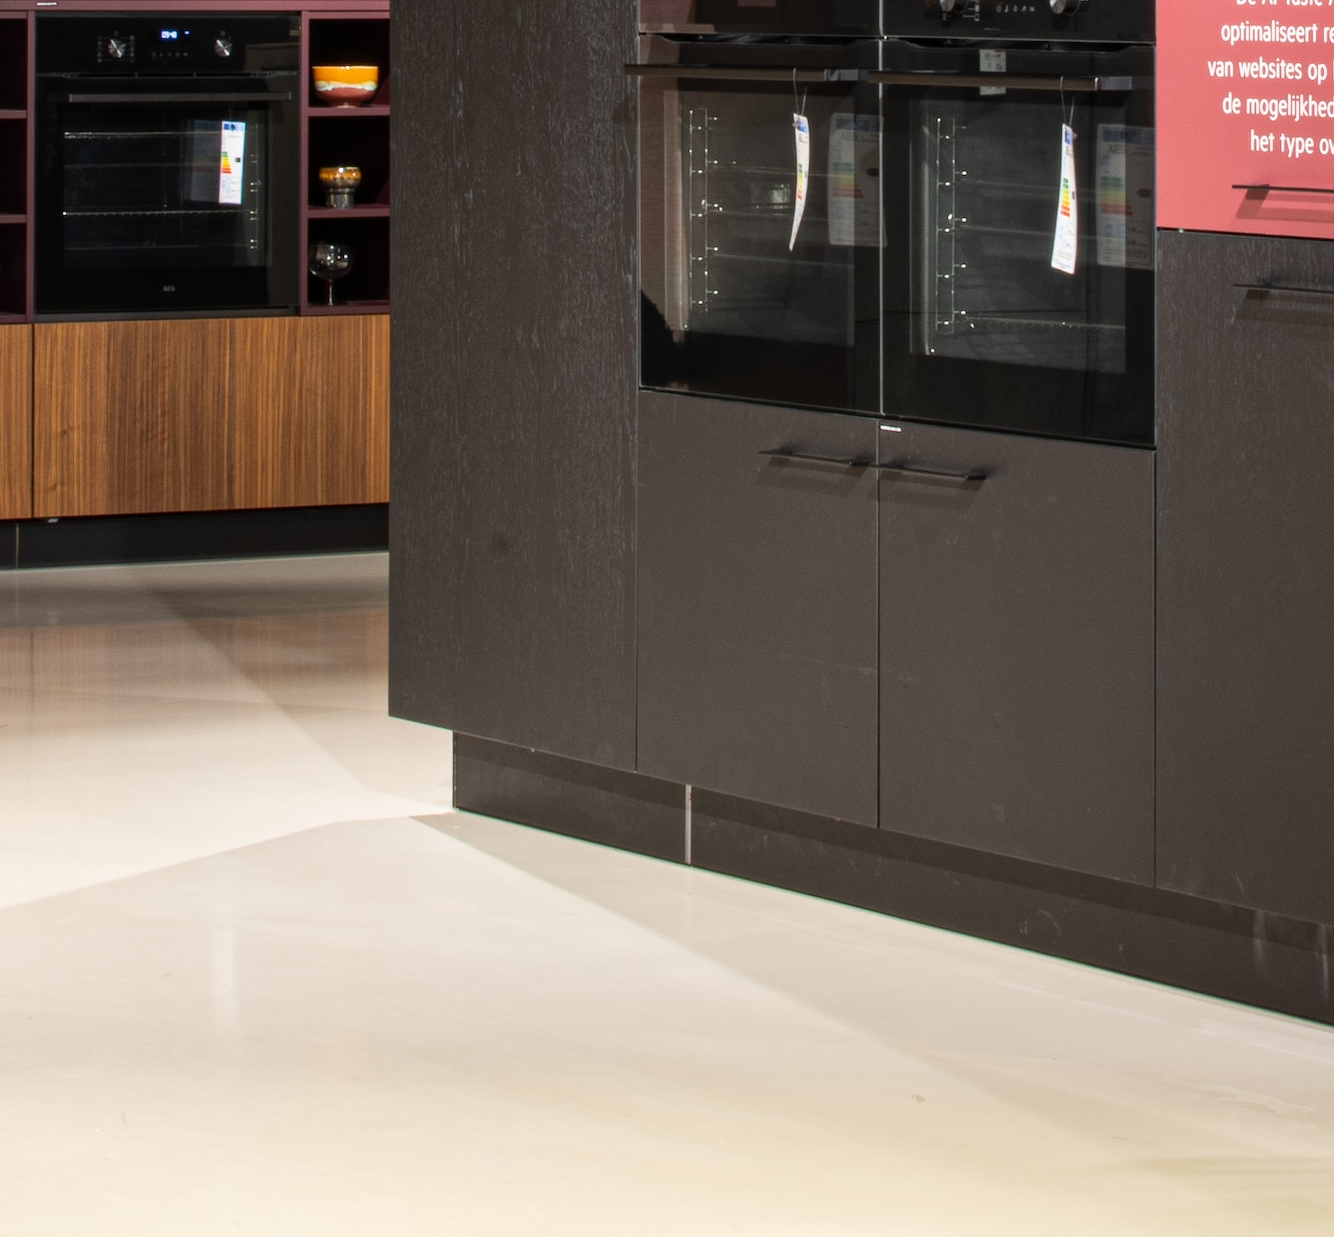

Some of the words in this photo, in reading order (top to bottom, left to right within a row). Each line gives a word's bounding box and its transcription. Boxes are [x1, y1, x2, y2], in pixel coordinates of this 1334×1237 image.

[1220, 20, 1318, 46] optimaliseert
[1207, 59, 1234, 78] van
[1238, 56, 1303, 81] websites
[1307, 61, 1328, 85] op
[1221, 92, 1242, 115] de
[1249, 129, 1275, 153] het
[1279, 133, 1315, 158] type
